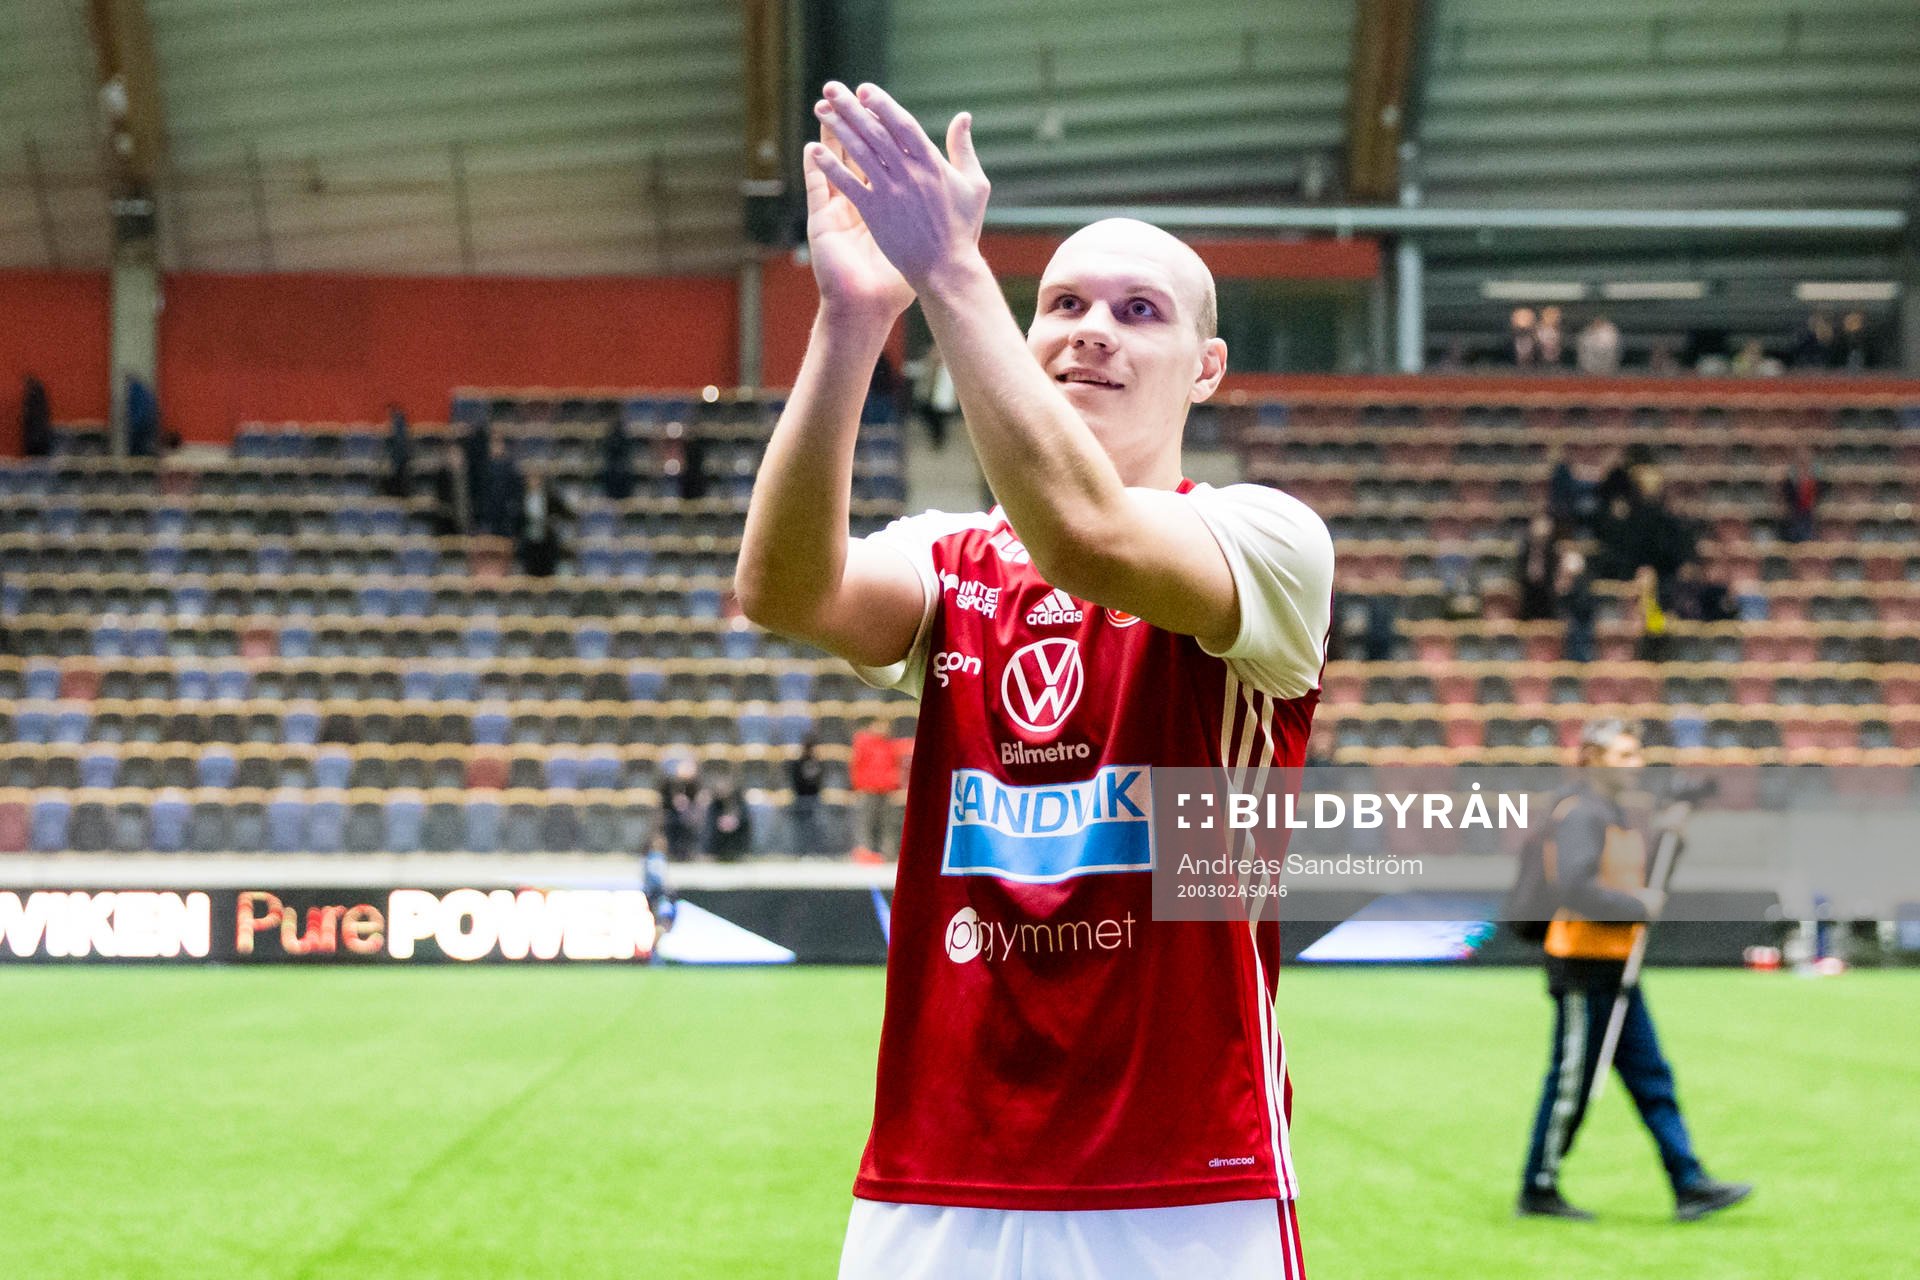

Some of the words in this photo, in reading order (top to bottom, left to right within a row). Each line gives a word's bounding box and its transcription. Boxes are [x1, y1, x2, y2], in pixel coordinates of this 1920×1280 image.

[956, 594, 998, 619] SPOR
[1026, 610, 1083, 625] adidas
[1000, 741, 1090, 765] Bilmetro
[0, 891, 210, 957] VIKEN
[236, 891, 385, 954] Pure
[1208, 1156, 1255, 1168] climacool
